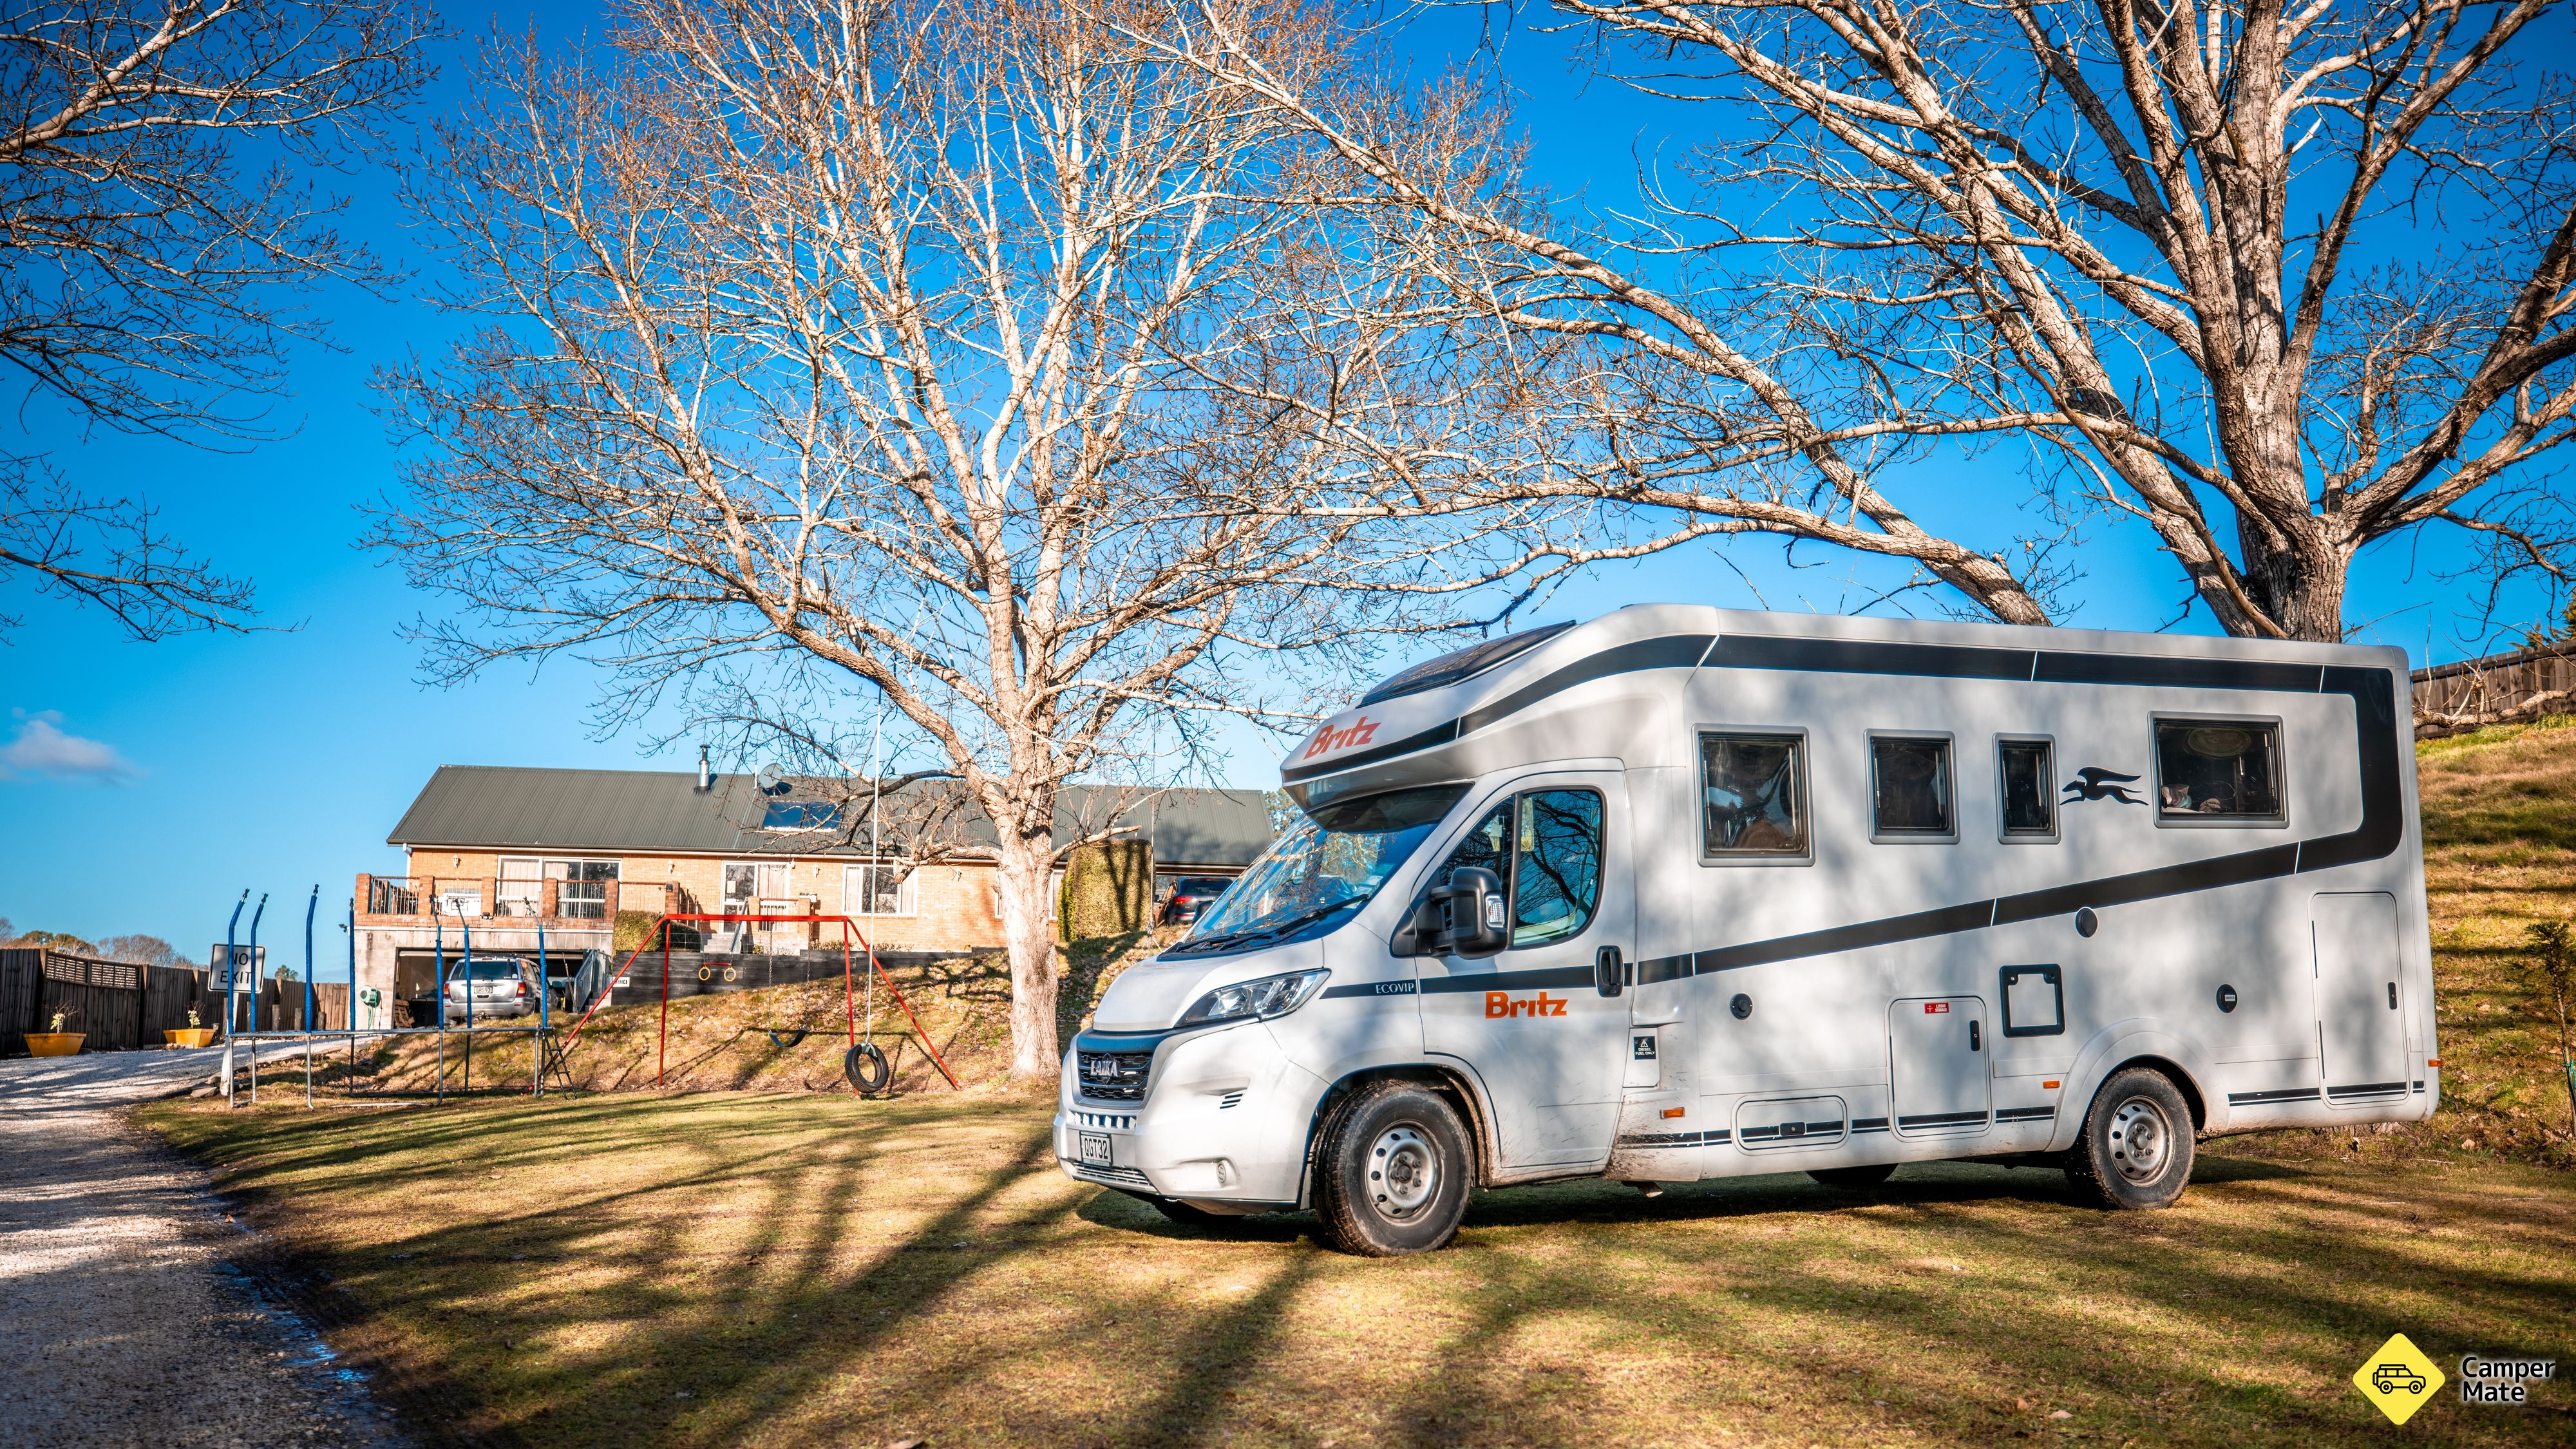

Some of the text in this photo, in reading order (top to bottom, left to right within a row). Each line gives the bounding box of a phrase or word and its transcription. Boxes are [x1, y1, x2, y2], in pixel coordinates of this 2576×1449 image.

[1303, 715, 1381, 760] Britz
[227, 952, 249, 965] NO
[220, 970, 252, 984] EXIT
[1376, 982, 1414, 994] ECOVIP
[1485, 991, 1568, 1019] Britz
[1090, 1060, 1119, 1077] LAIKA
[1084, 1137, 1108, 1159] QGT32
